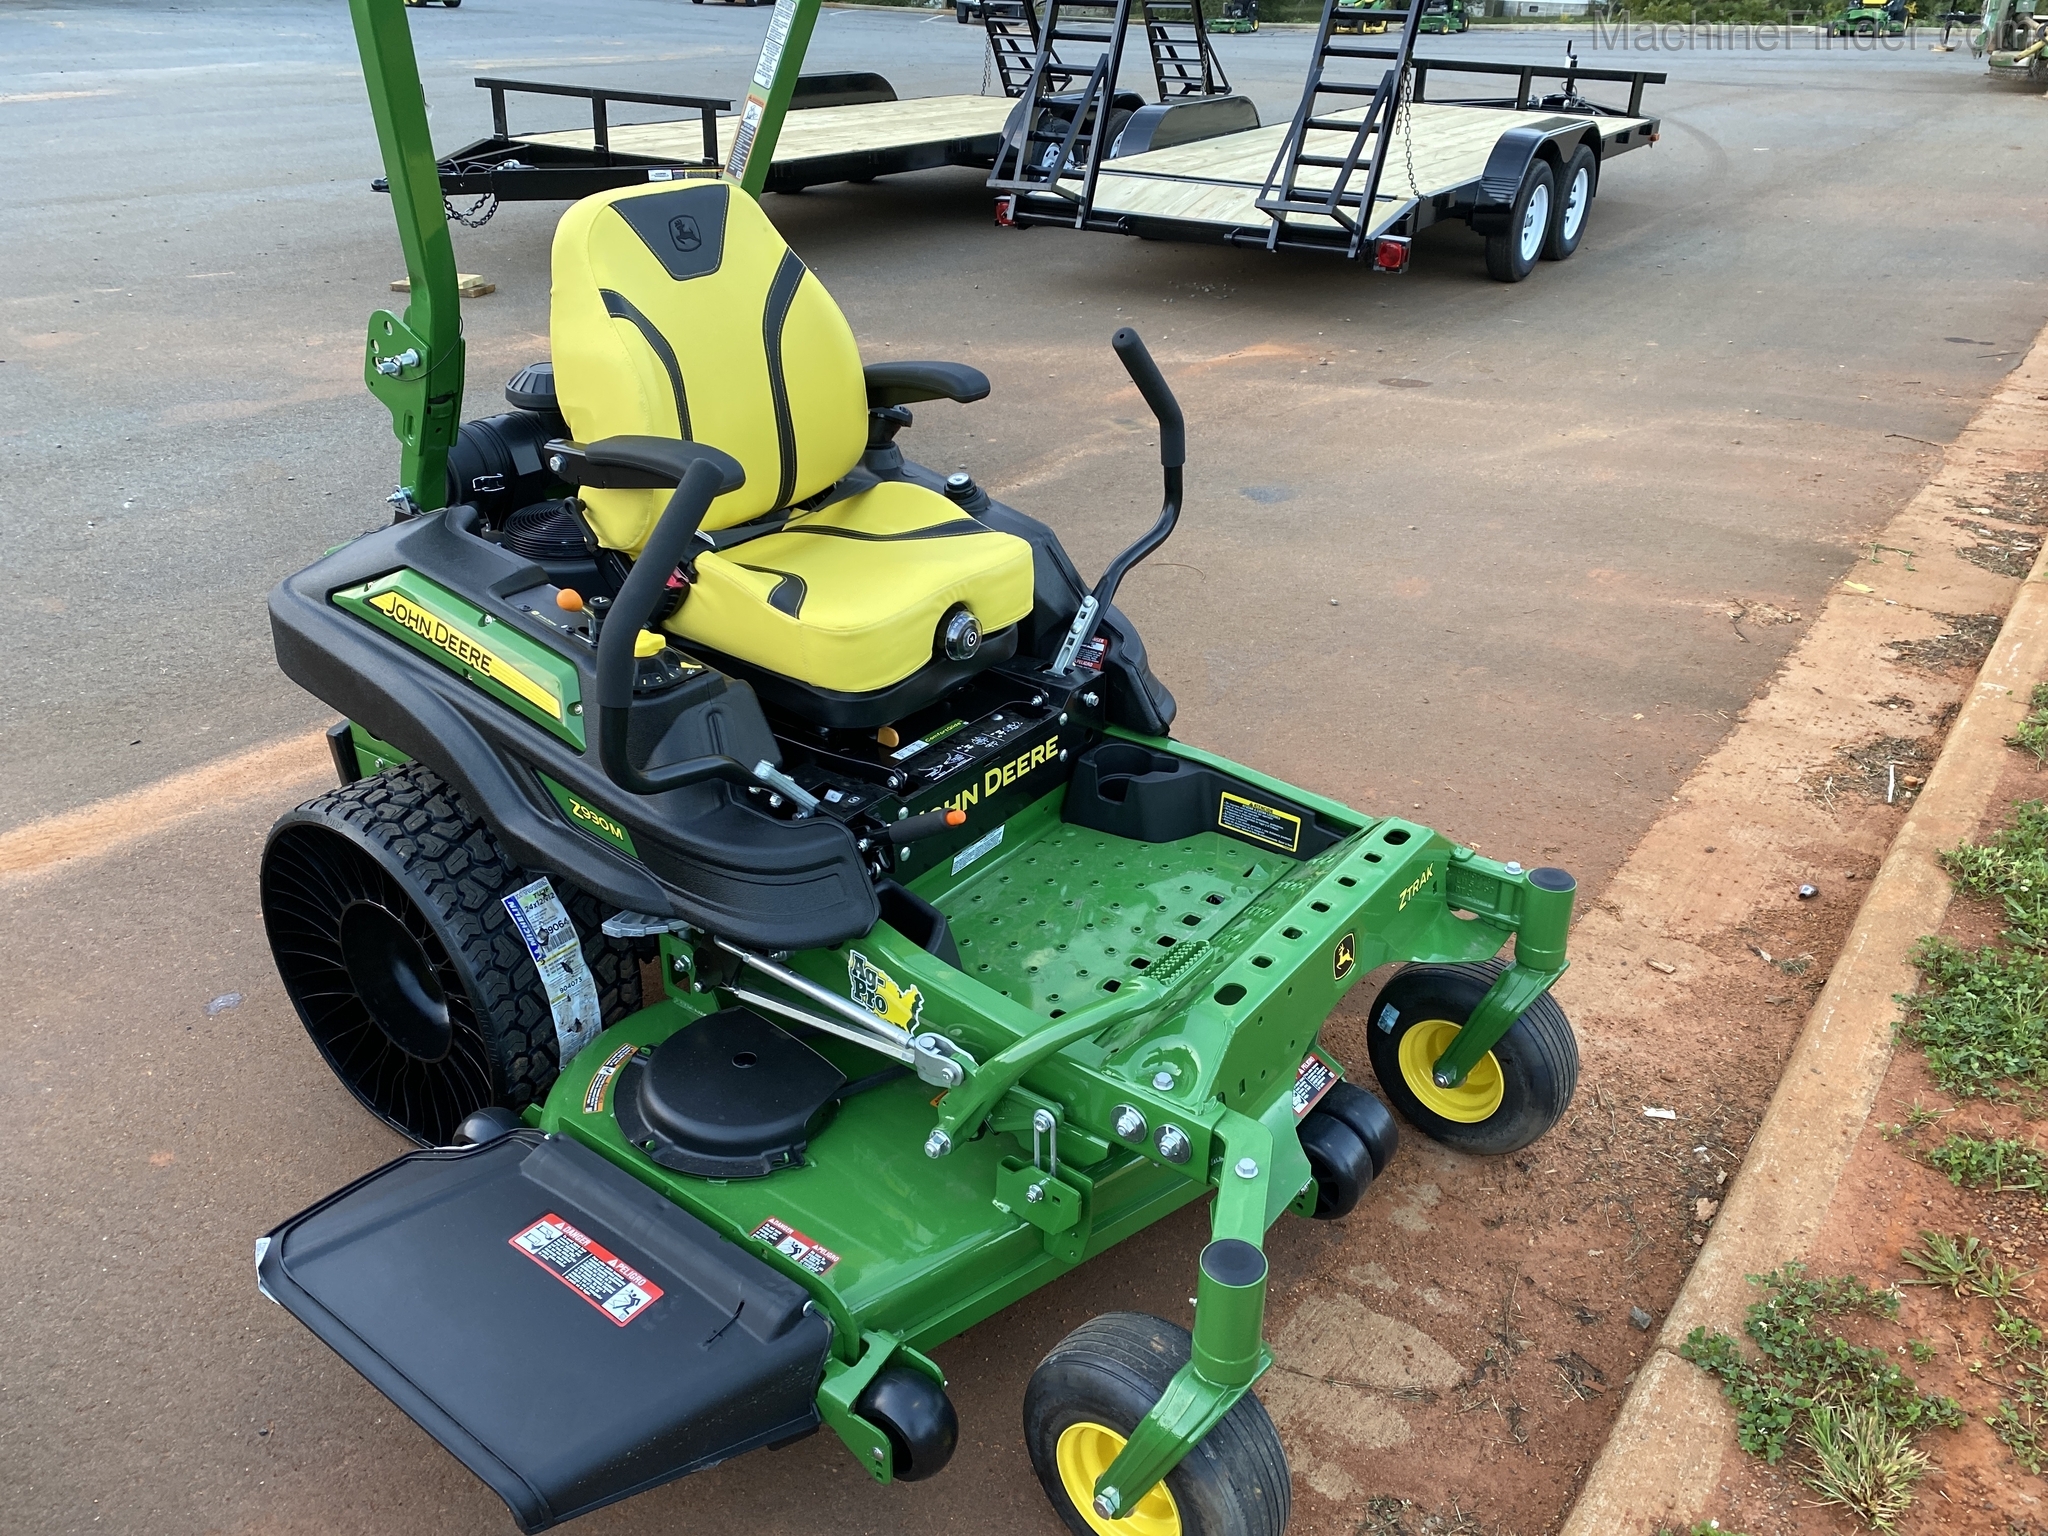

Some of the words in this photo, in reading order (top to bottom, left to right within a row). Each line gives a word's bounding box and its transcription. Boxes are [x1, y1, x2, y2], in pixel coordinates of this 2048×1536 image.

[385, 597, 431, 637] JOHN
[434, 622, 492, 673] DEERE
[985, 735, 1059, 798] DEERE
[569, 797, 624, 841] Z930M
[508, 900, 537, 947] MICHELIN
[562, 1225, 592, 1248] DANGER
[615, 1262, 647, 1287] PELIGRO
